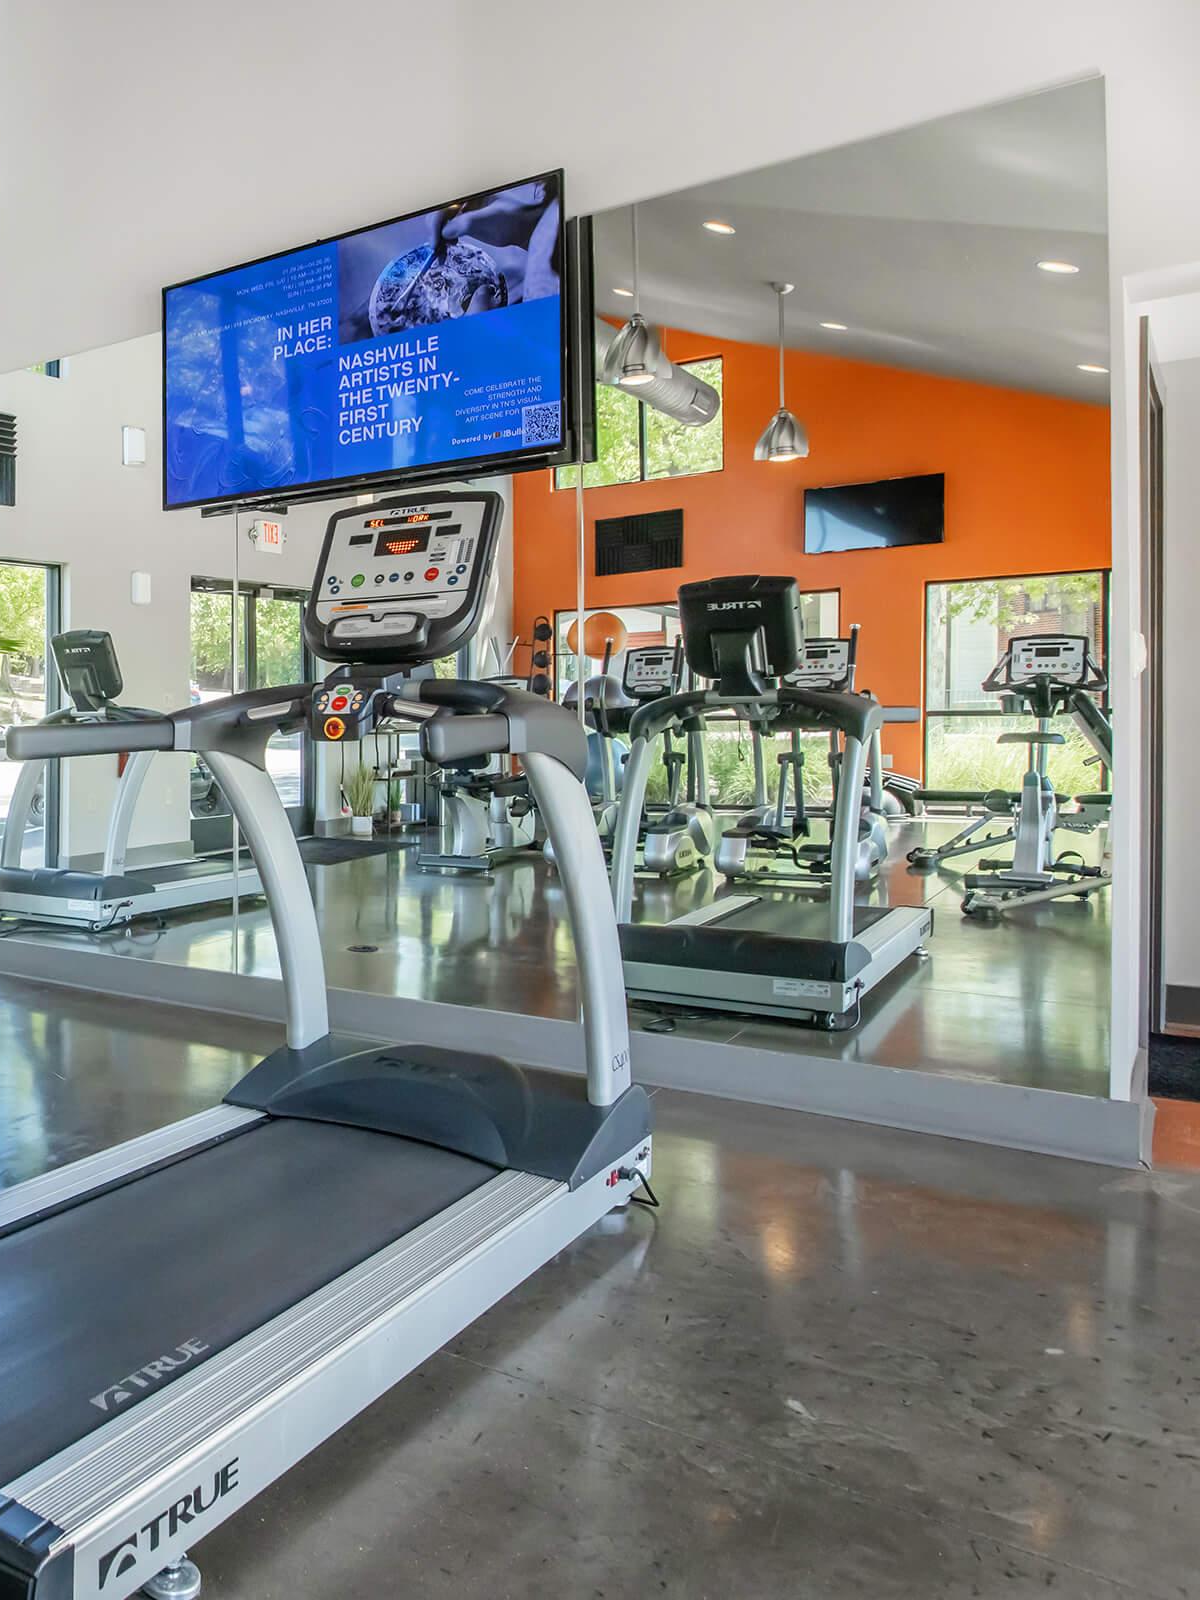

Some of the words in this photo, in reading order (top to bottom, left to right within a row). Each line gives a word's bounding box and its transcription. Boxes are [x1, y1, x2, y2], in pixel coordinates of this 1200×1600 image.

[277, 325, 293, 342] IN
[298, 316, 332, 337] HER
[273, 335, 332, 361] PLACE:
[339, 336, 439, 372] NASHVILLE
[339, 362, 413, 390] ARTISTS
[419, 356, 437, 373] IN
[464, 387, 484, 396] COME
[485, 379, 526, 392] CELEBRATE
[528, 375, 541, 383] THE
[339, 388, 373, 408] THE
[376, 371, 460, 401] TWENTY-
[488, 389, 525, 401] STRENGTH
[526, 385, 542, 393] AND
[339, 404, 388, 427] FIRST
[456, 405, 490, 416] DIVERSITY
[517, 396, 541, 405] VISUAL
[465, 415, 479, 423] ART
[480, 412, 503, 421] SCENE
[505, 408, 520, 417] FOR
[339, 416, 423, 445] CENTURY
[452, 433, 481, 445] Powered
[484, 431, 492, 441] by
[120, 1337, 209, 1387] TRUE
[141, 1457, 239, 1551] TRUE
